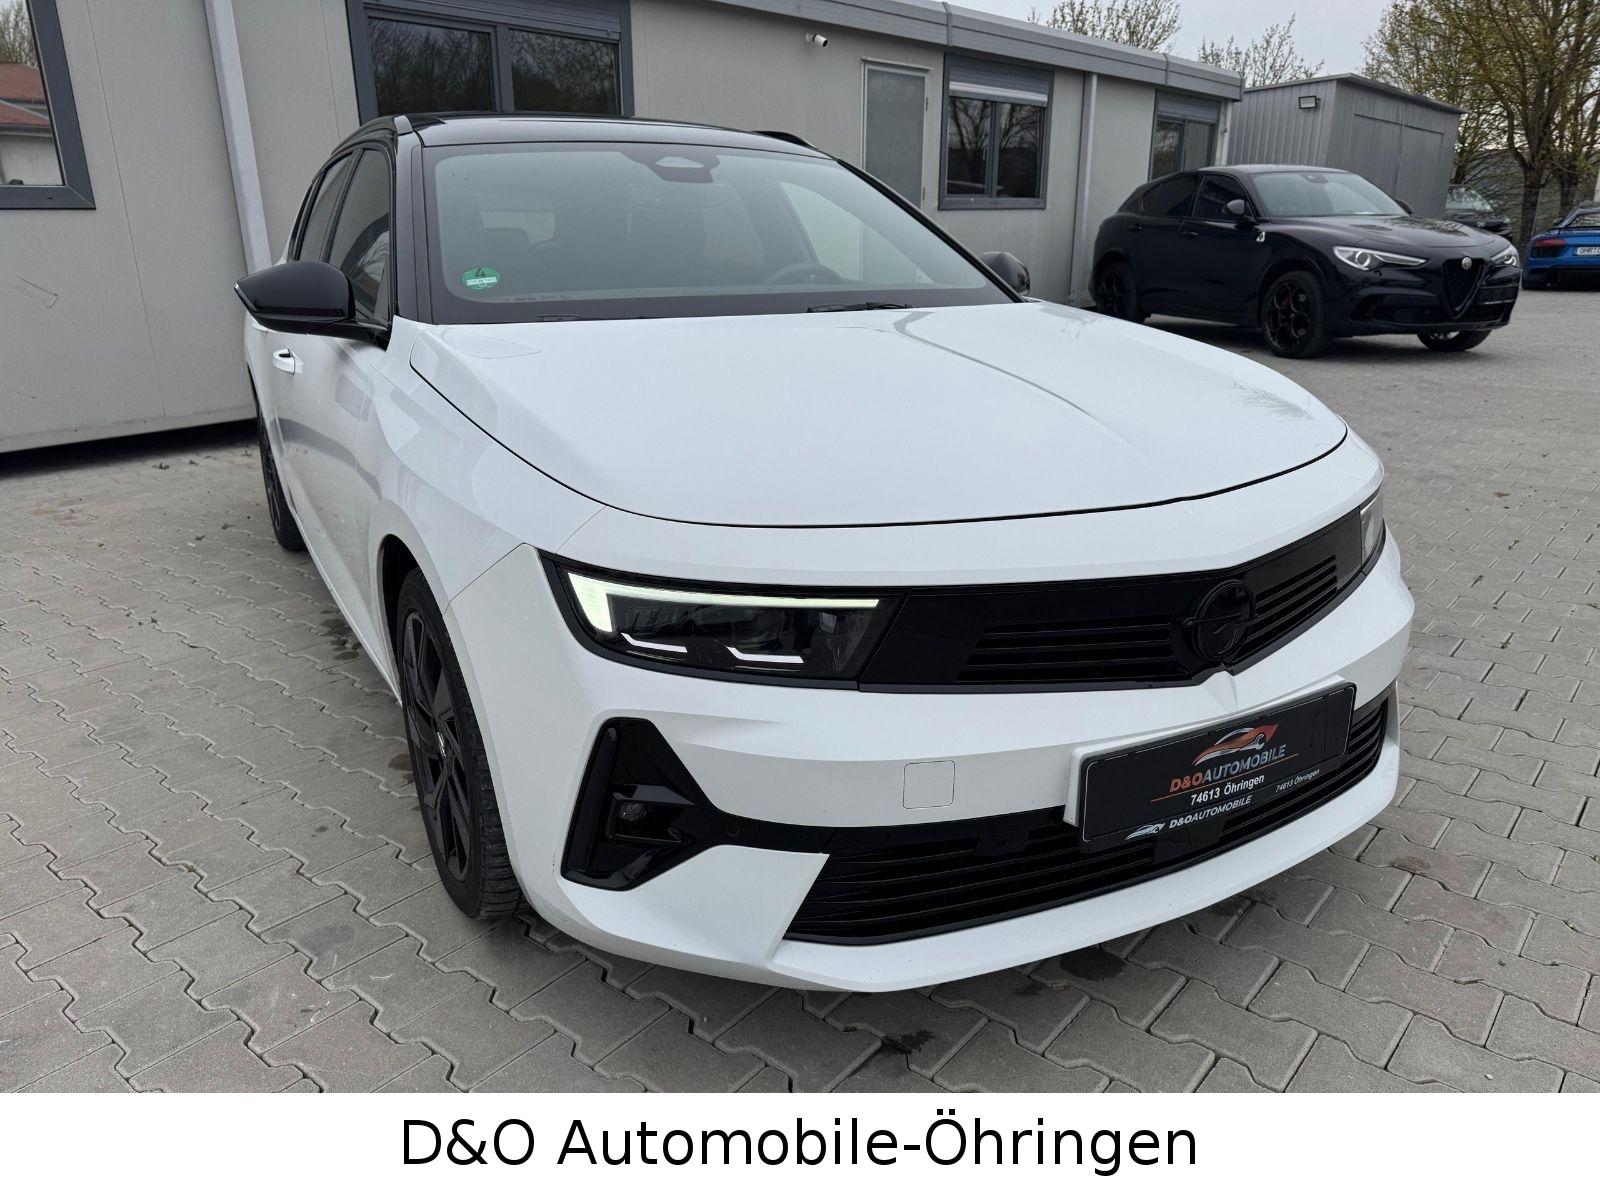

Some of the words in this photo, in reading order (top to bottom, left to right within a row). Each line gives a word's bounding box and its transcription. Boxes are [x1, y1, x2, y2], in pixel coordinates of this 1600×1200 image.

[475, 267, 487, 278] 4
[1190, 787, 1220, 806] 74613
[1223, 774, 1265, 796] Öhringen
[1275, 779, 1294, 793] 74613
[1294, 768, 1320, 786] Öhringen
